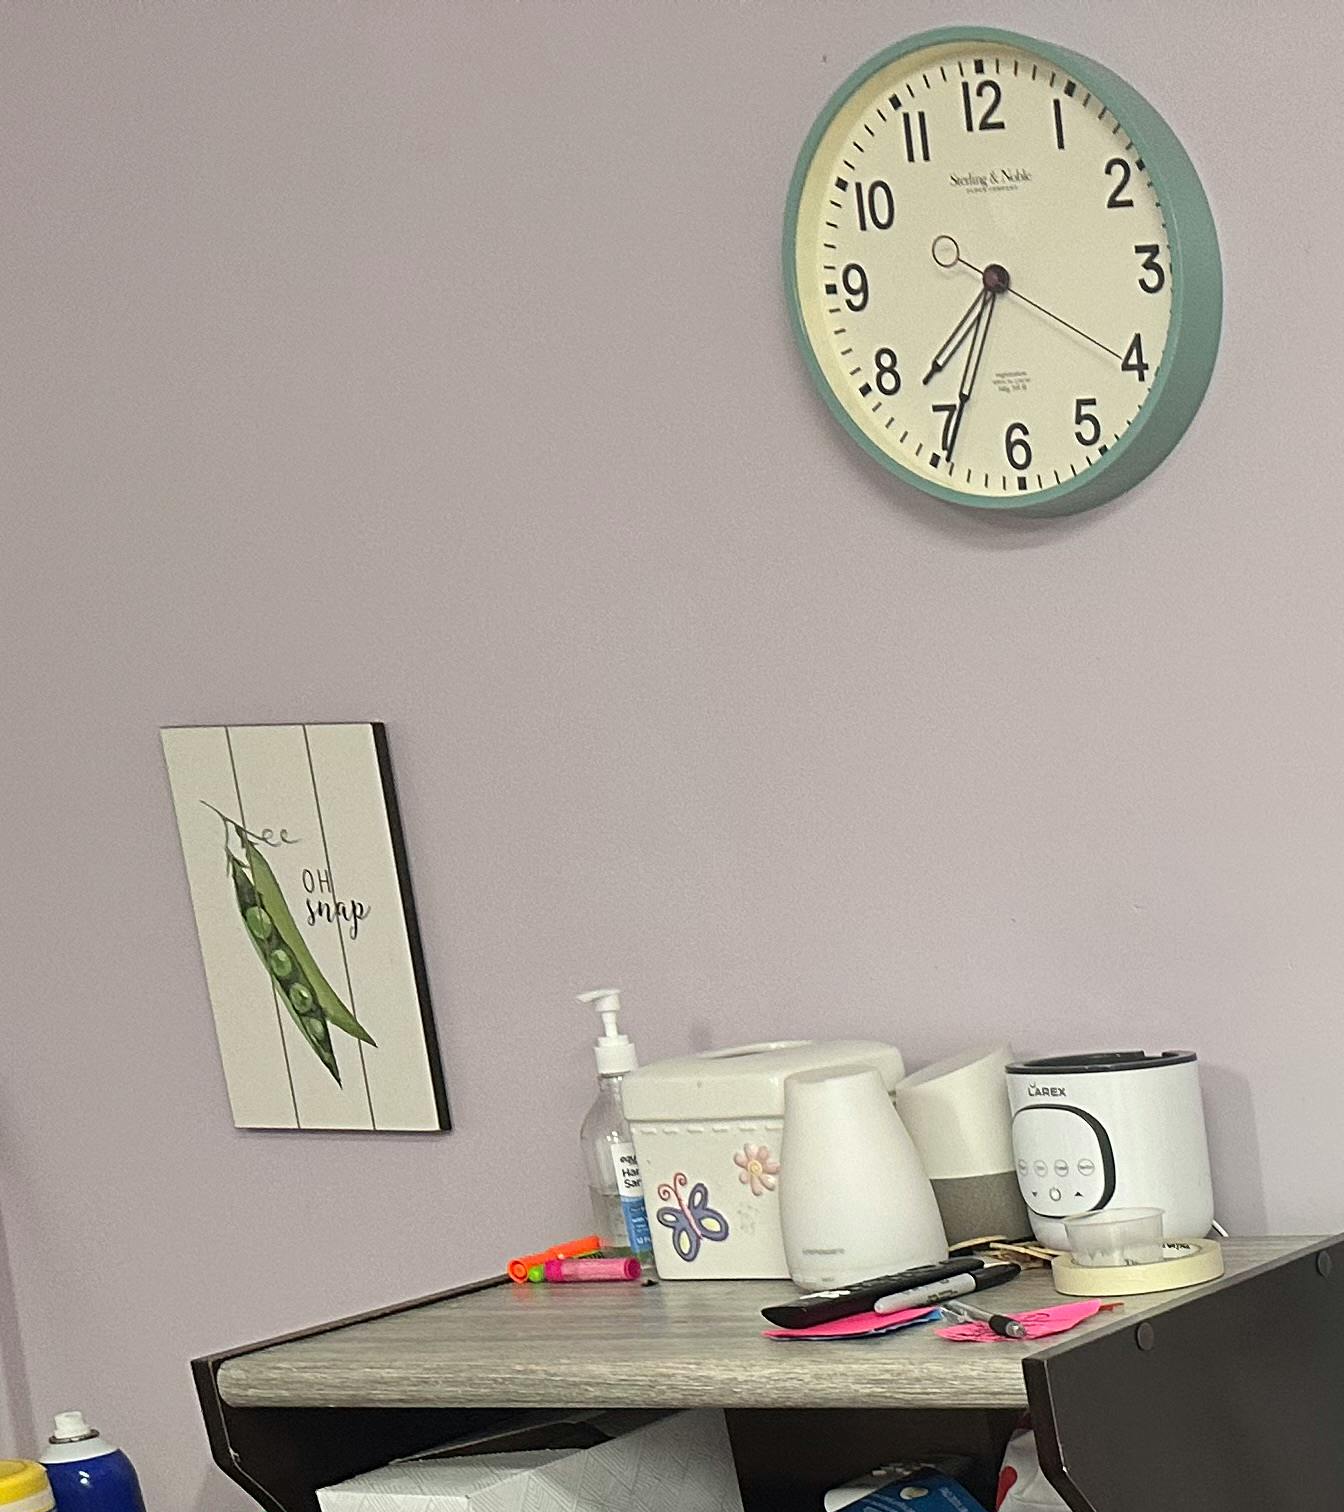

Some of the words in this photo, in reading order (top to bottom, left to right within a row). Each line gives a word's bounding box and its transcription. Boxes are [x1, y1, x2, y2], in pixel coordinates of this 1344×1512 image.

[962, 79, 1006, 132] 12
[1053, 98, 1065, 150] 1
[903, 111, 930, 163] 11
[855, 180, 895, 231] 10
[1104, 157, 1133, 209] 2
[842, 263, 870, 312] 9
[1134, 244, 1165, 294] 3
[875, 348, 901, 396] 8
[1121, 333, 1149, 382] 4
[932, 404, 957, 452] 7
[1005, 422, 1033, 470] 6
[1074, 398, 1101, 446] 5
[302, 868, 332, 895] OH
[306, 899, 369, 940] snap
